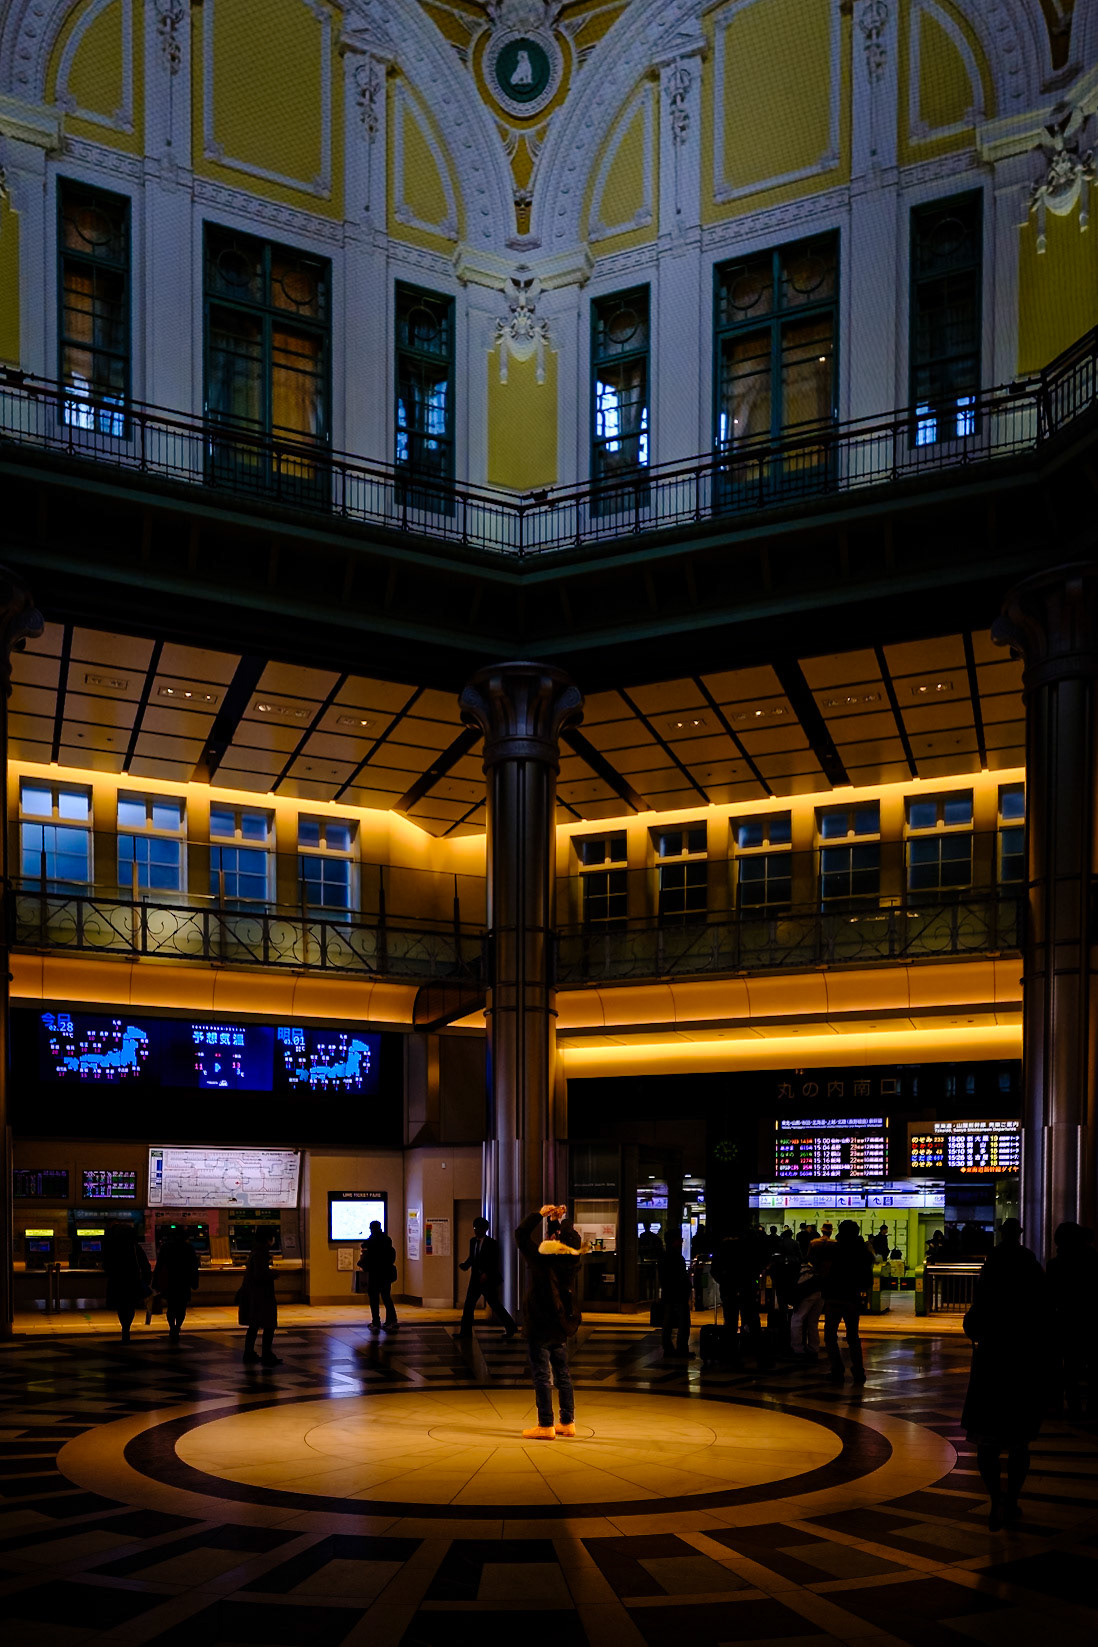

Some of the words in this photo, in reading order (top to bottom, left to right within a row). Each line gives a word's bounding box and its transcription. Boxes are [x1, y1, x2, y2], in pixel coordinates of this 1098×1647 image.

[777, 1079, 897, 1099] 丸の内南口
